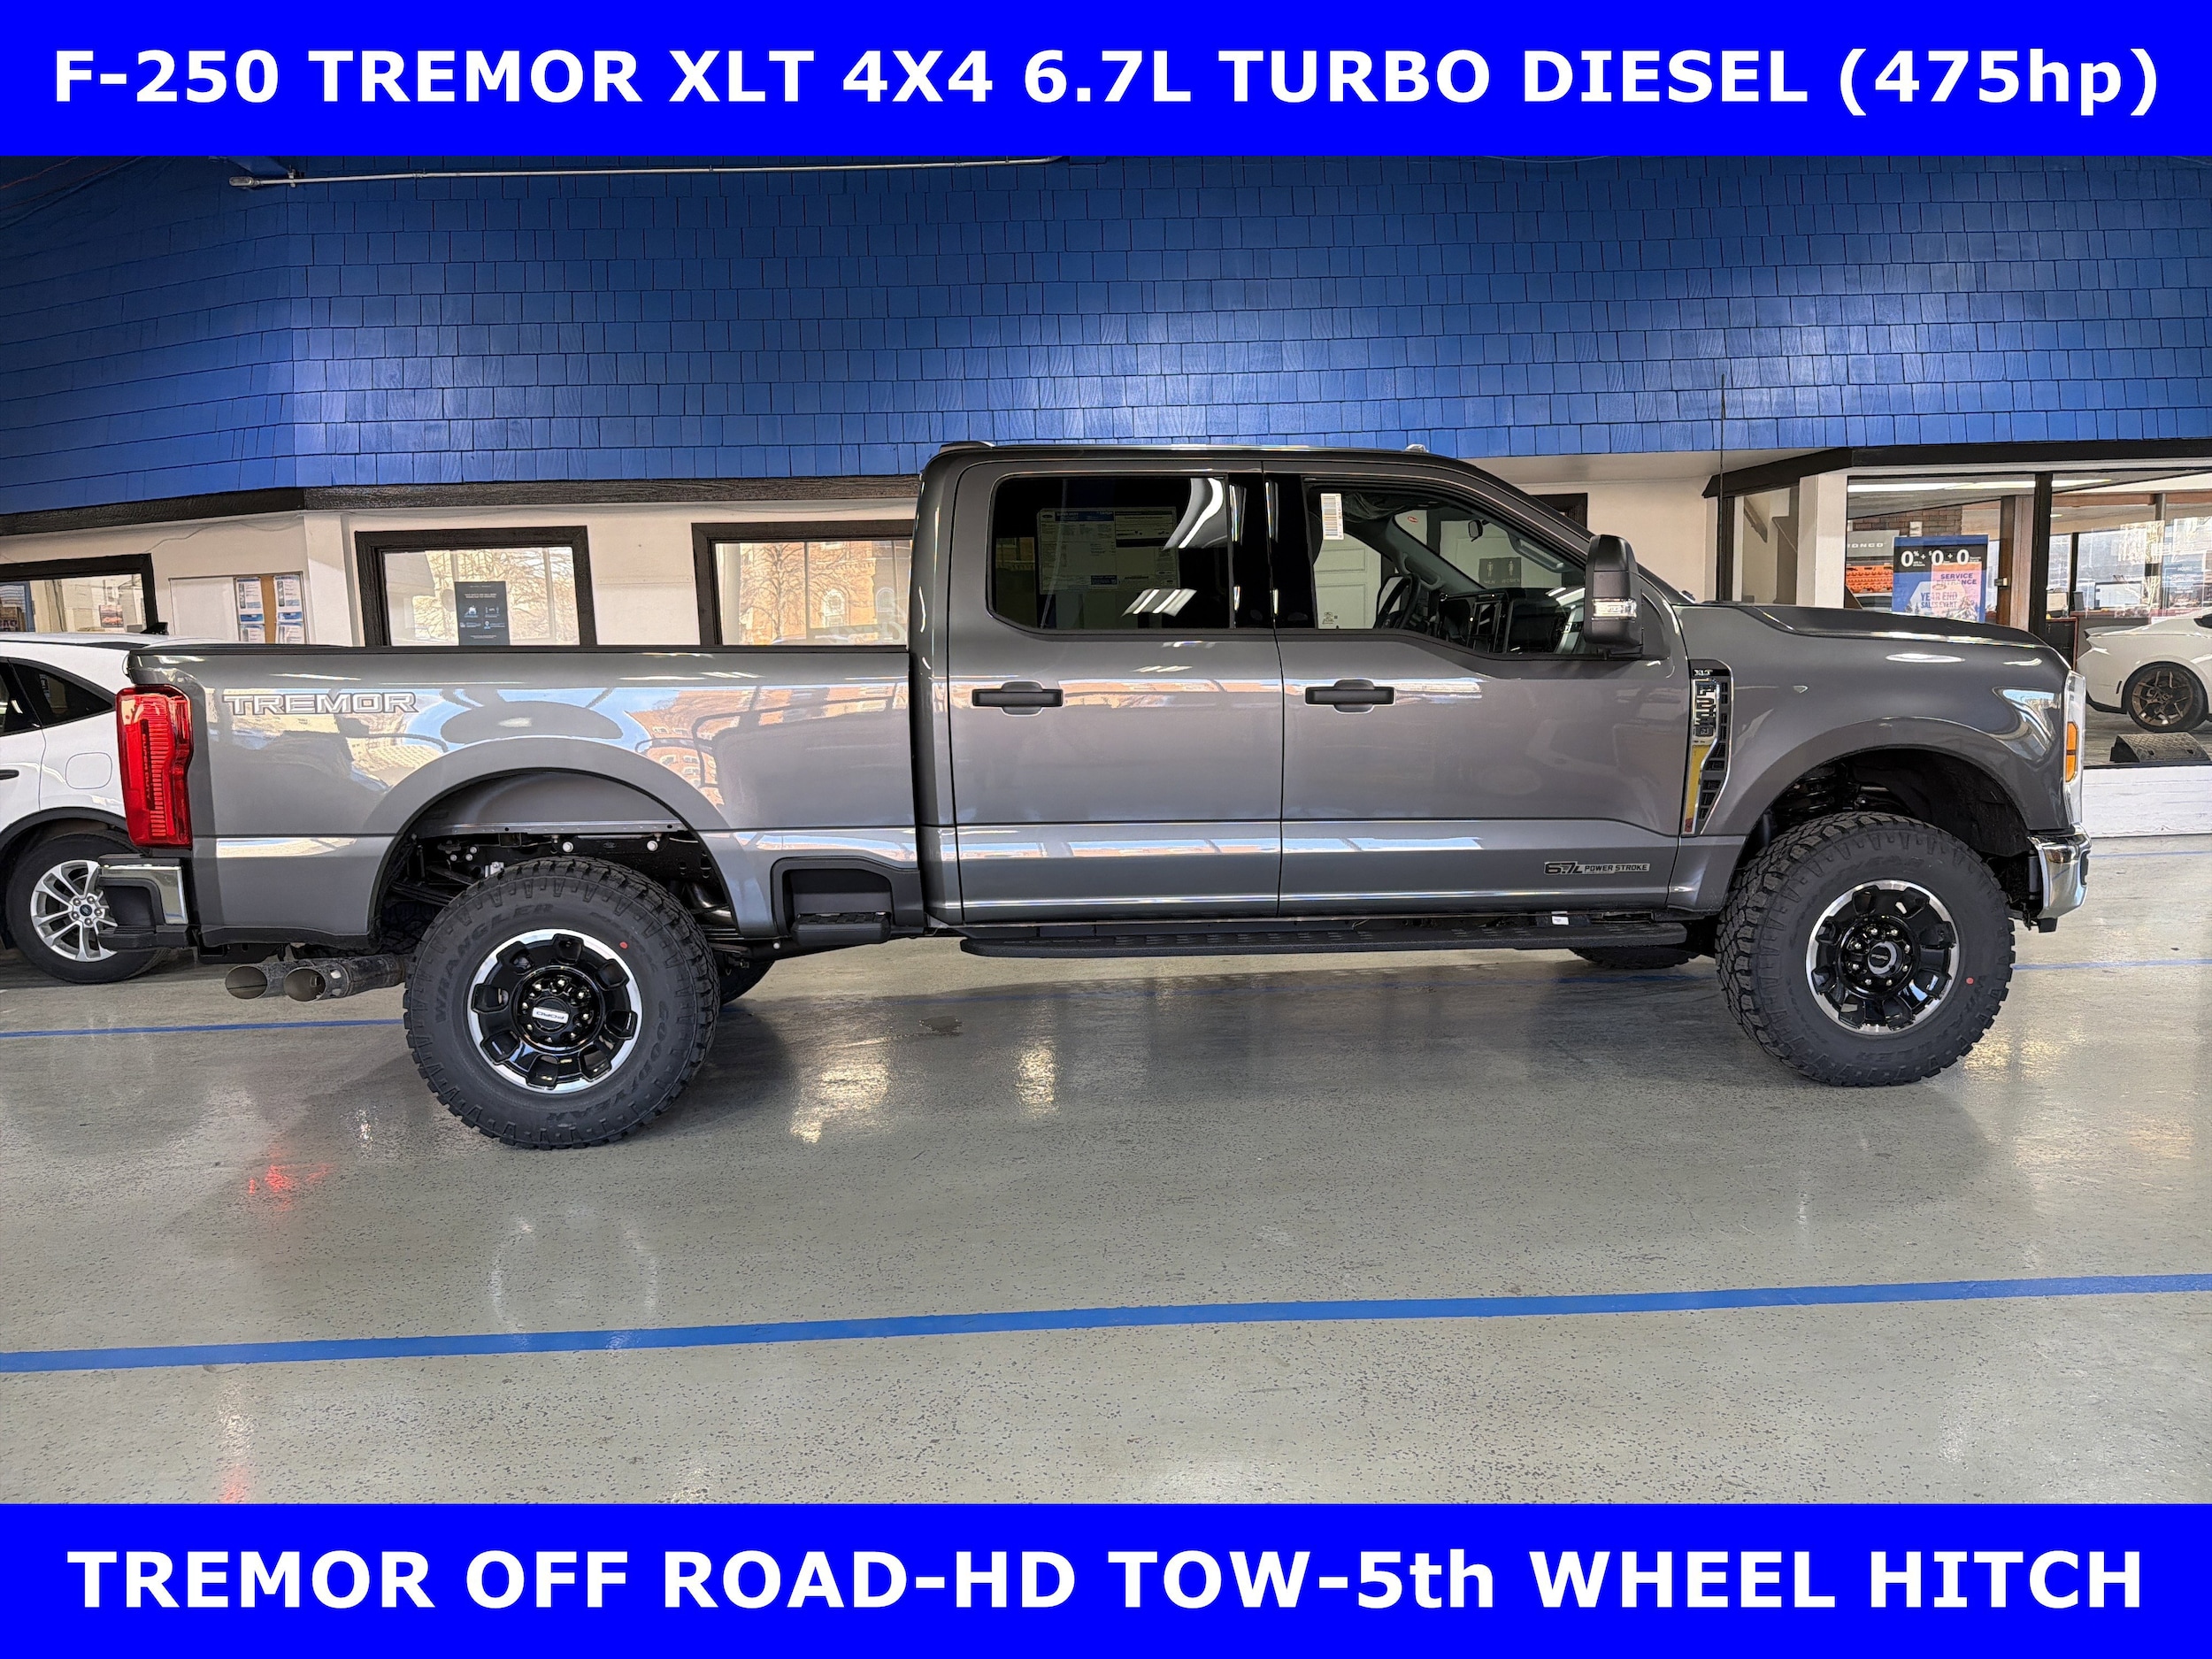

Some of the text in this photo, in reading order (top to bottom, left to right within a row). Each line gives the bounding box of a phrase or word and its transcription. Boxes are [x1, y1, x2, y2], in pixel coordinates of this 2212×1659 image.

[222, 693, 419, 715] TREMOR
[1544, 861, 1583, 874] 6.7L
[536, 1010, 565, 1020] FORD
